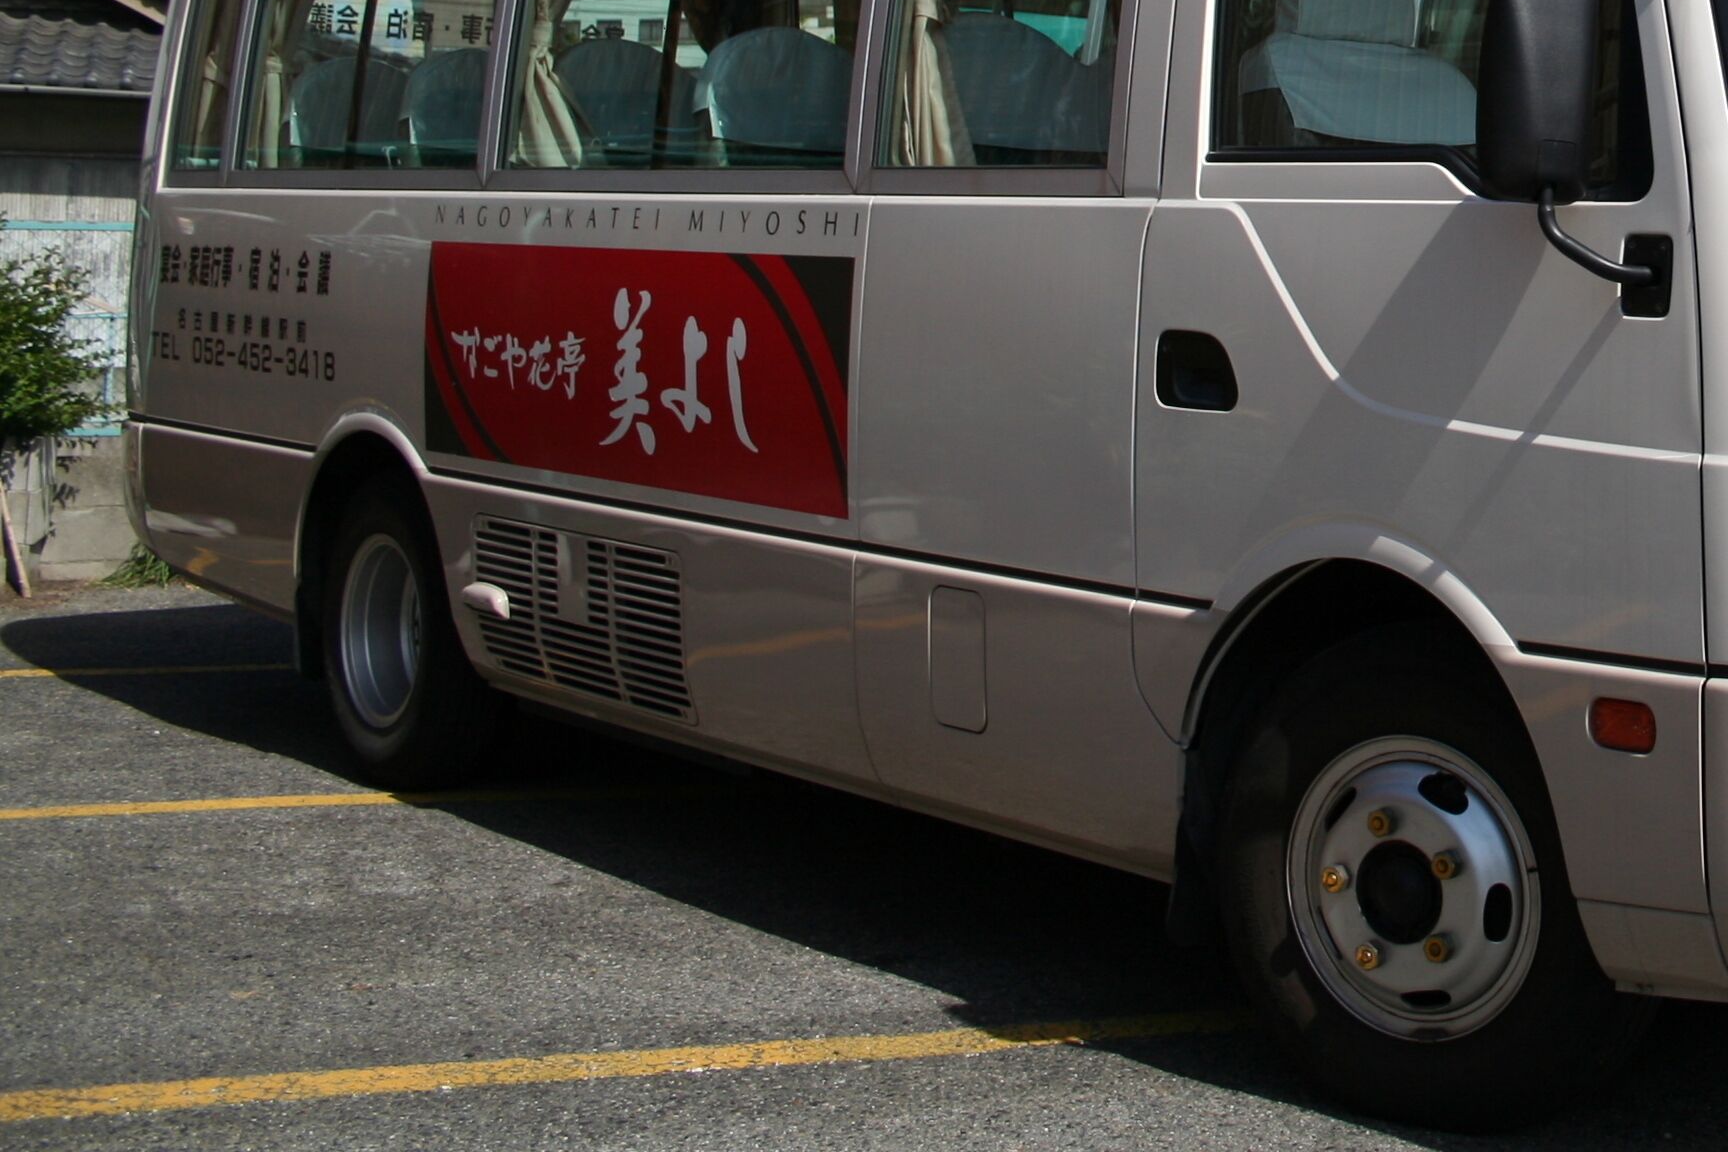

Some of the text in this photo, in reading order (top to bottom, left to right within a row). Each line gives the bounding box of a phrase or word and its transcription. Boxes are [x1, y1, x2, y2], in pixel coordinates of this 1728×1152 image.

[435, 204, 861, 237] NAGOYAKATEI MIYOSHI
[152, 331, 336, 382] TEL 052-452-3418
[599, 287, 758, 455] 美よし
